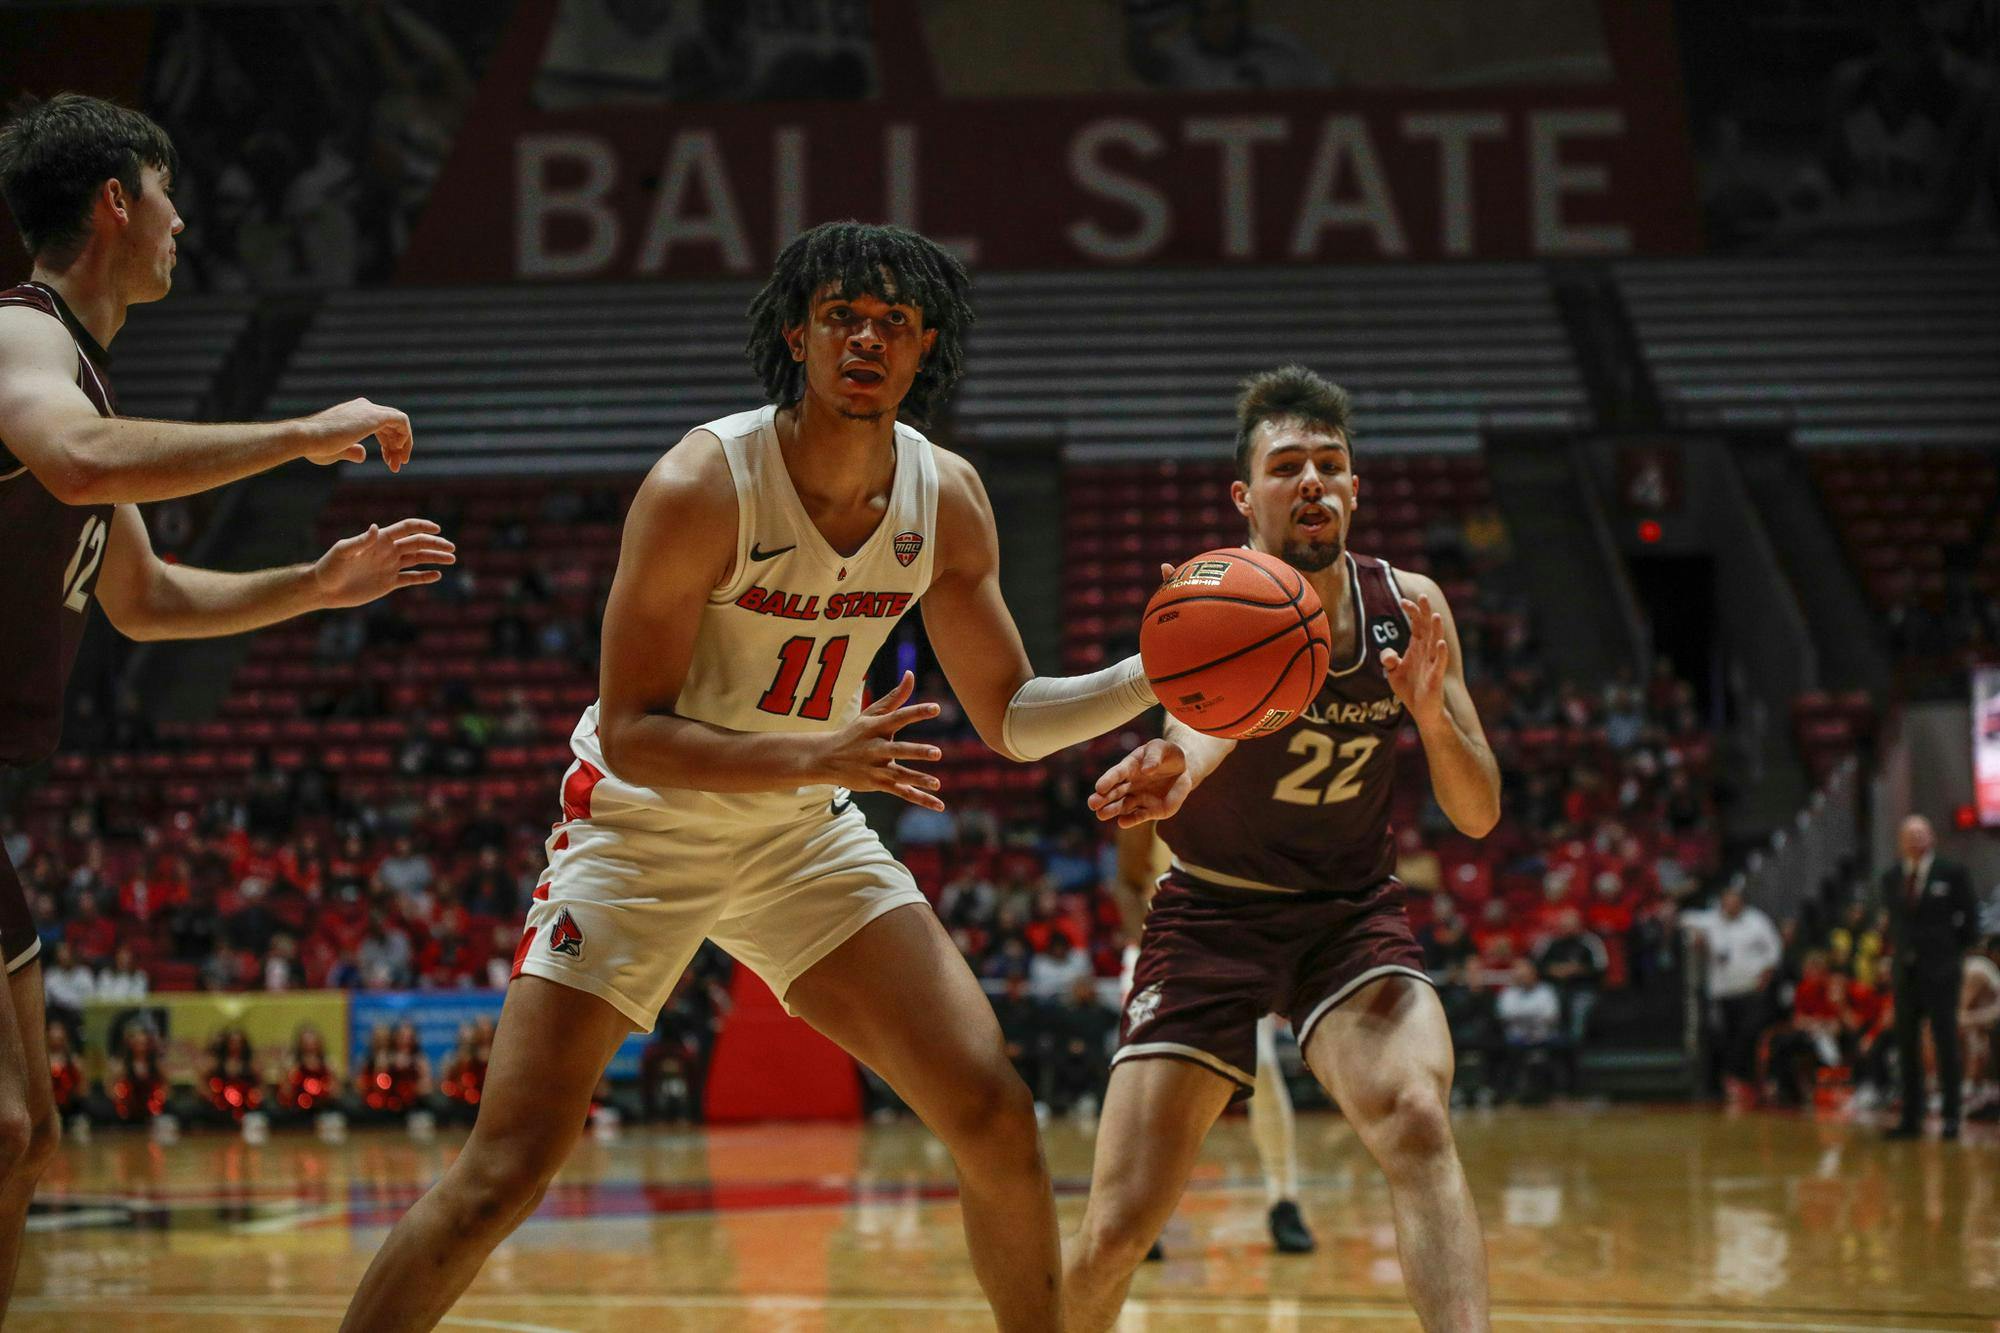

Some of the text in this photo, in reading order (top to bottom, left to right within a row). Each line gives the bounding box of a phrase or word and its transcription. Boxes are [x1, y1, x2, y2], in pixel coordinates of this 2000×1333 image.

[514, 109, 1635, 276] BALL STATE
[62, 513, 106, 615] 12
[895, 542, 921, 553] MAC
[735, 585, 913, 621] BALL STATE
[1372, 620, 1399, 644] CG
[756, 635, 849, 721] 11
[1271, 729, 1382, 807] 22
